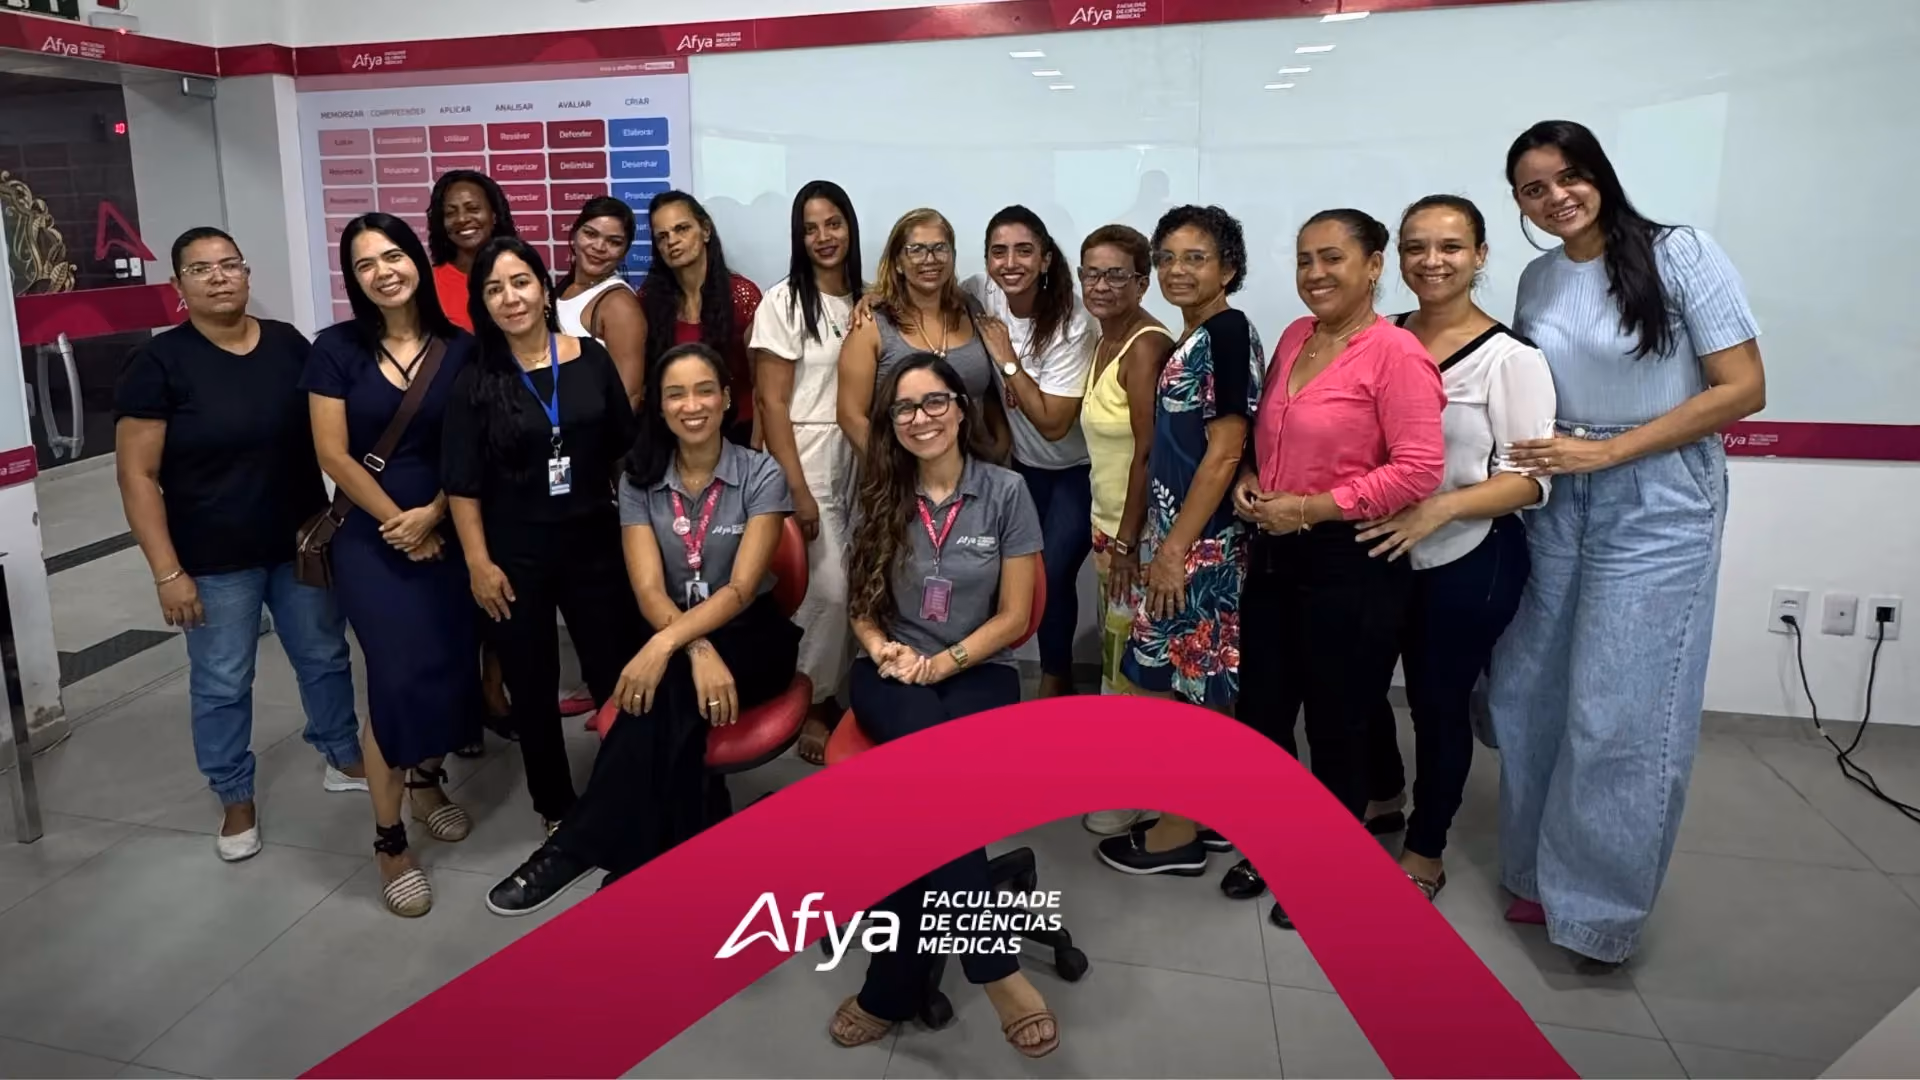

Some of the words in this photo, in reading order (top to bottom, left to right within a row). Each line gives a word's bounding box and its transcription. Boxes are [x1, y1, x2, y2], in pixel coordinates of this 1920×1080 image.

[1069, 7, 1112, 25] Afya
[41, 36, 79, 56] Afya
[676, 34, 713, 52] Afya
[352, 53, 382, 70] Afya
[558, 100, 592, 109] AVALIAR
[625, 97, 650, 106] CRIAR
[440, 105, 471, 114] APLICAR
[495, 103, 534, 112] ANALISAR
[560, 130, 592, 139] Defender
[623, 129, 654, 137] Elaborar
[496, 163, 538, 173] Categorizar
[560, 161, 595, 170] Delimitar
[622, 160, 658, 169] Desenhar
[564, 192, 594, 201] Estimar
[1723, 433, 1746, 448] fya
